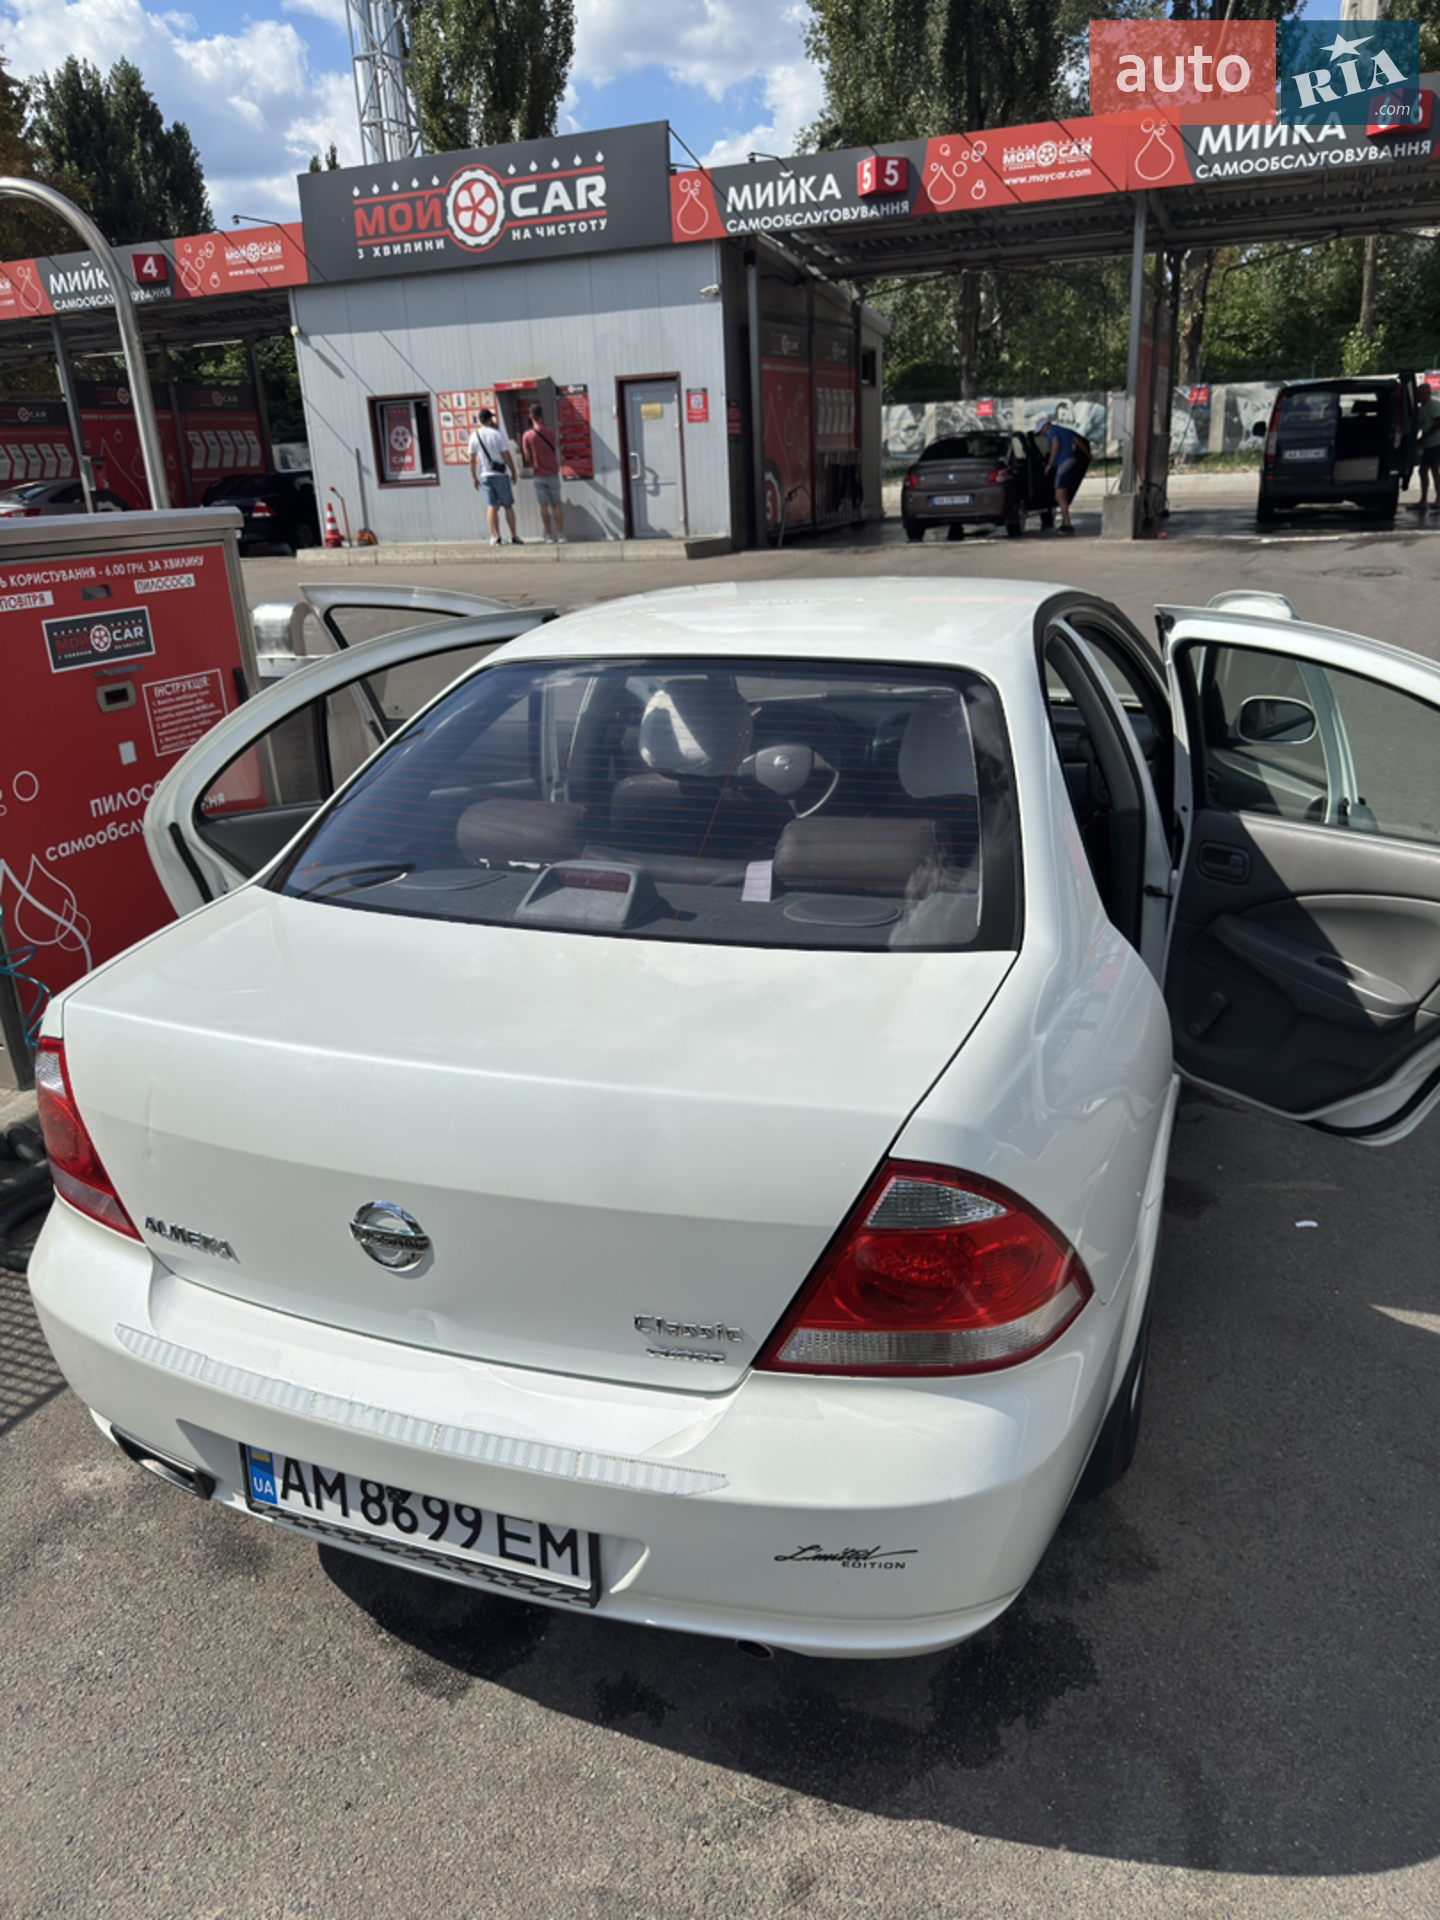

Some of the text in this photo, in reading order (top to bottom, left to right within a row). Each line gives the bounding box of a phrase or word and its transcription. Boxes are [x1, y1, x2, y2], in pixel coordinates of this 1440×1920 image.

[1198, 108, 1347, 156] МИЙКА
[1059, 143, 1092, 157] CAR
[1196, 140, 1432, 178] САМООБСЛУГОВУВАННЯ
[862, 159, 900, 190] 5 5
[510, 174, 607, 218] CAR
[726, 170, 842, 213] МИЙКА
[726, 200, 910, 233] САМООБСЛУГОВУВАННЯ
[261, 245, 281, 256] CAR
[373, 238, 446, 258] ХВИЛИНИ
[511, 229, 532, 241] НА
[538, 218, 608, 238] ЧИСТОТУ
[50, 260, 110, 295] МИЙК
[142, 256, 158, 278] 4
[9, 567, 97, 588] КОРИСТУВАННЯ
[105, 564, 125, 578] 6,00
[127, 562, 146, 576] ГРН.
[148, 559, 161, 571] ЗА
[163, 555, 204, 570] ХВИЛИНУ
[112, 627, 144, 641] CAR
[145, 1216, 241, 1264] ALMERA
[634, 1313, 743, 1343] Classic
[253, 1476, 274, 1497] UA
[280, 1456, 350, 1518] AM
[497, 1513, 580, 1577] EM
[774, 1544, 918, 1562] Limited
[841, 1560, 906, 1570] EDITION
